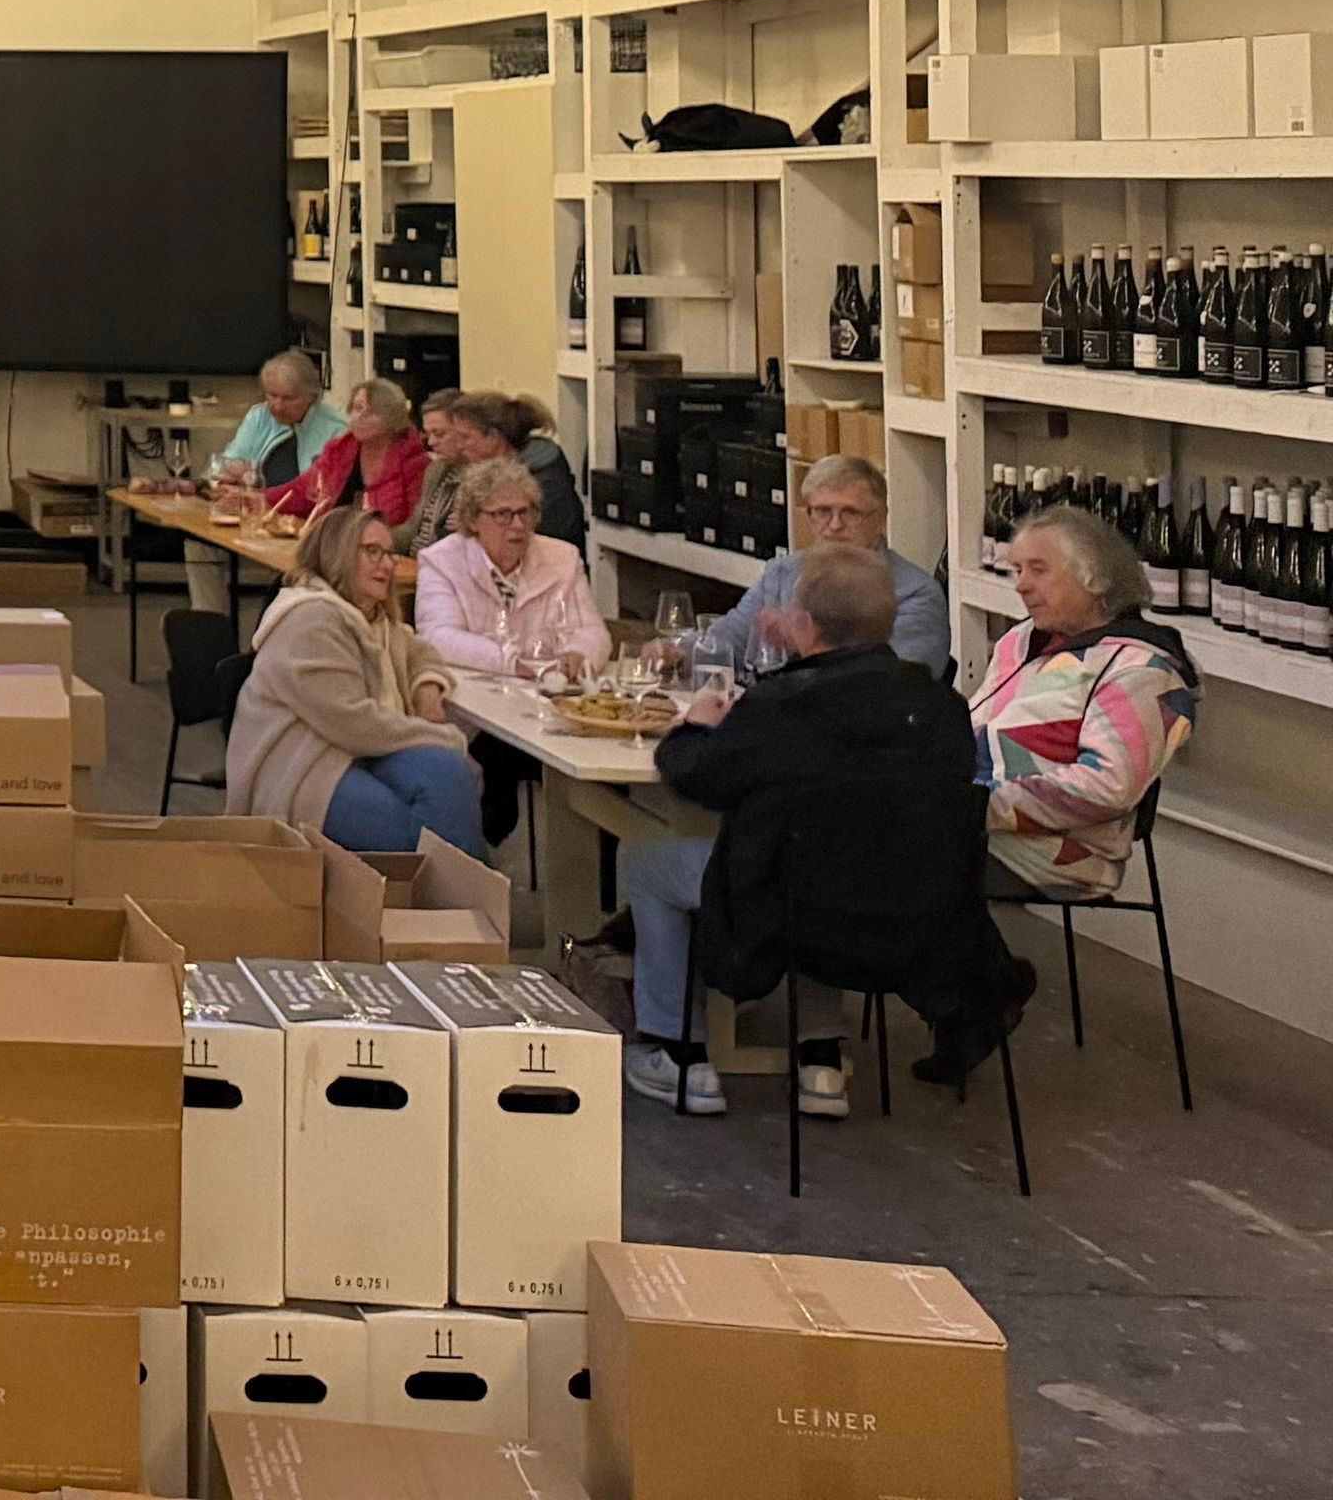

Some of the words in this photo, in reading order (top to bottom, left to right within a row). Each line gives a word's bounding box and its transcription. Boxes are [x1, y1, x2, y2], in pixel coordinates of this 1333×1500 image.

[0, 777, 28, 790] and
[33, 777, 62, 791] love
[1, 871, 29, 884] and
[34, 871, 63, 885] love
[22, 1223, 165, 1244] Philosophie
[191, 1276, 217, 1289] 0,75
[334, 1275, 342, 1287] 6
[356, 1276, 382, 1290] 0,75
[508, 1281, 515, 1293] 6
[530, 1282, 555, 1296] 0,75
[776, 1406, 878, 1431] LEINER
